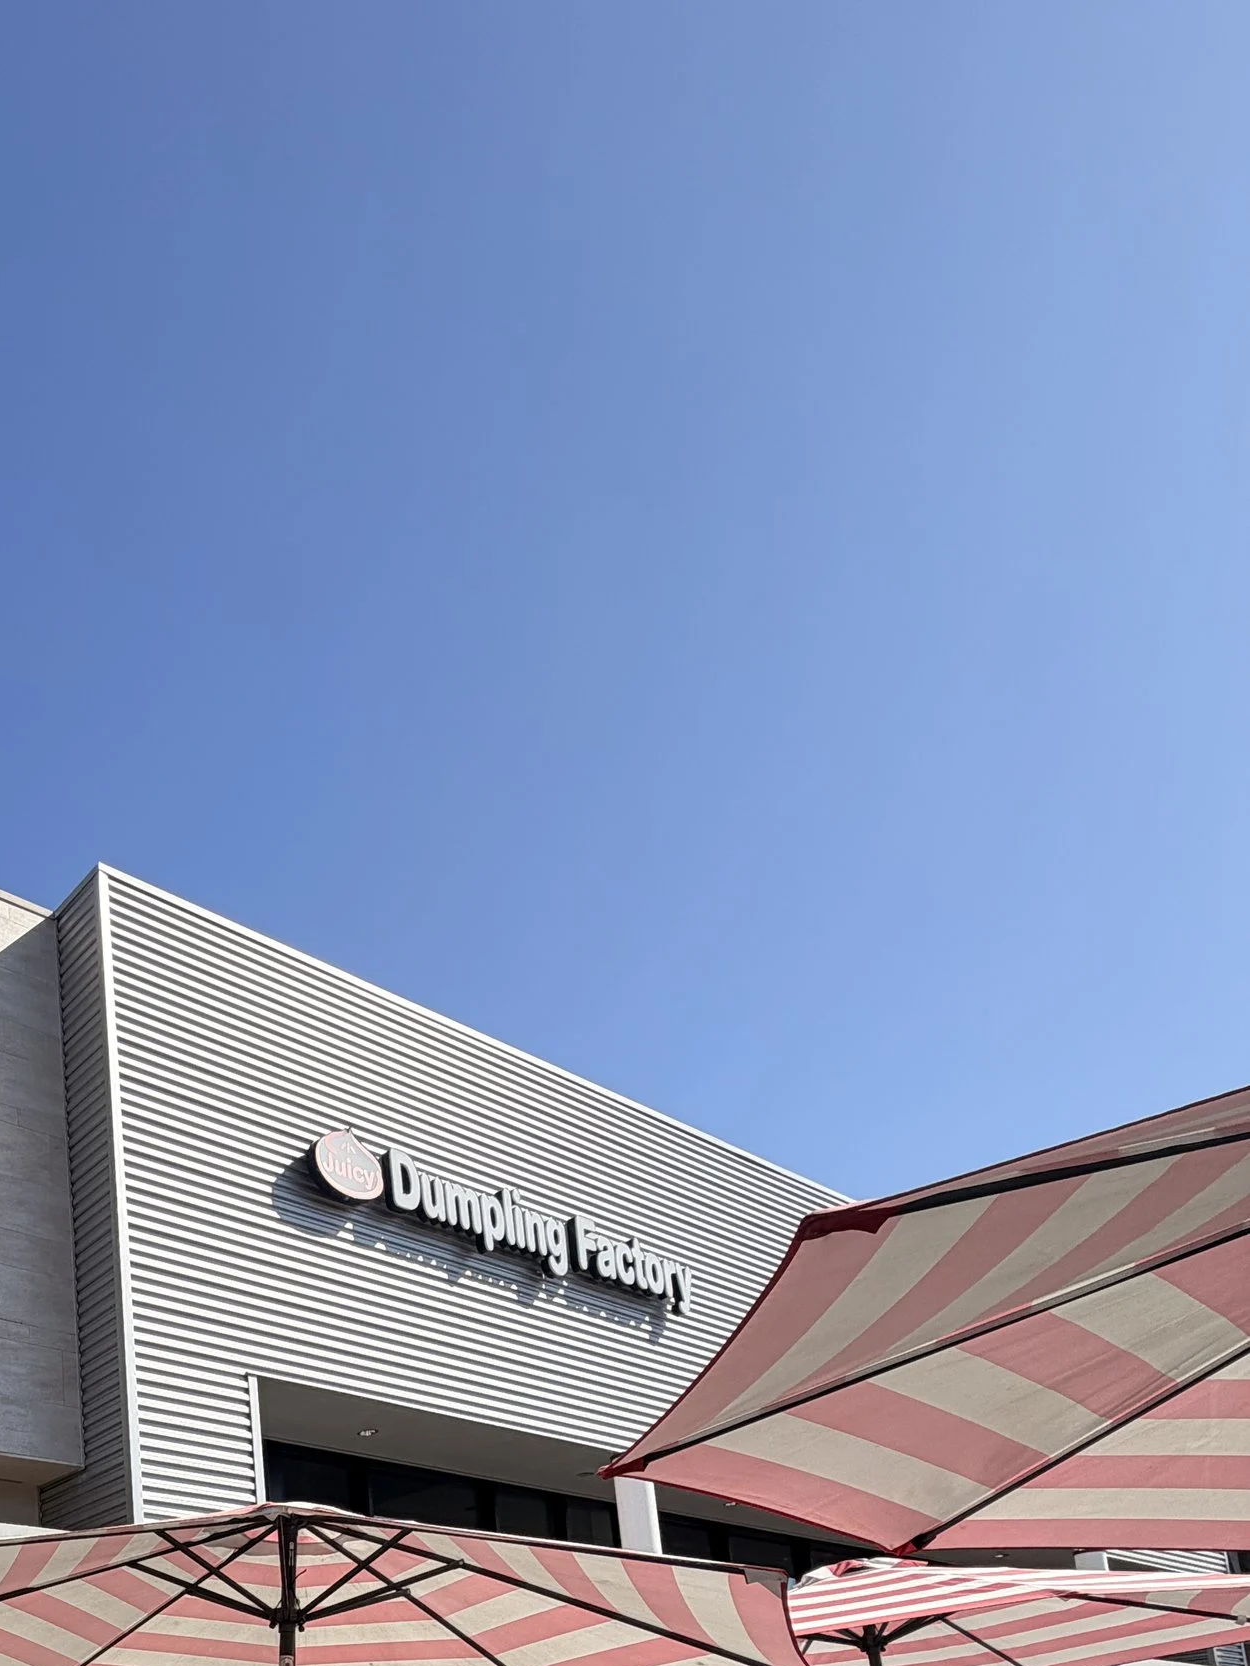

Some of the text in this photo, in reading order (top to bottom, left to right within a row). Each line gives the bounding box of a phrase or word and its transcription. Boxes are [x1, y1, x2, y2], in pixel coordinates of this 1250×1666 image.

[323, 1152, 375, 1190] Juicy
[389, 1148, 692, 1314] Dumpling Factory
